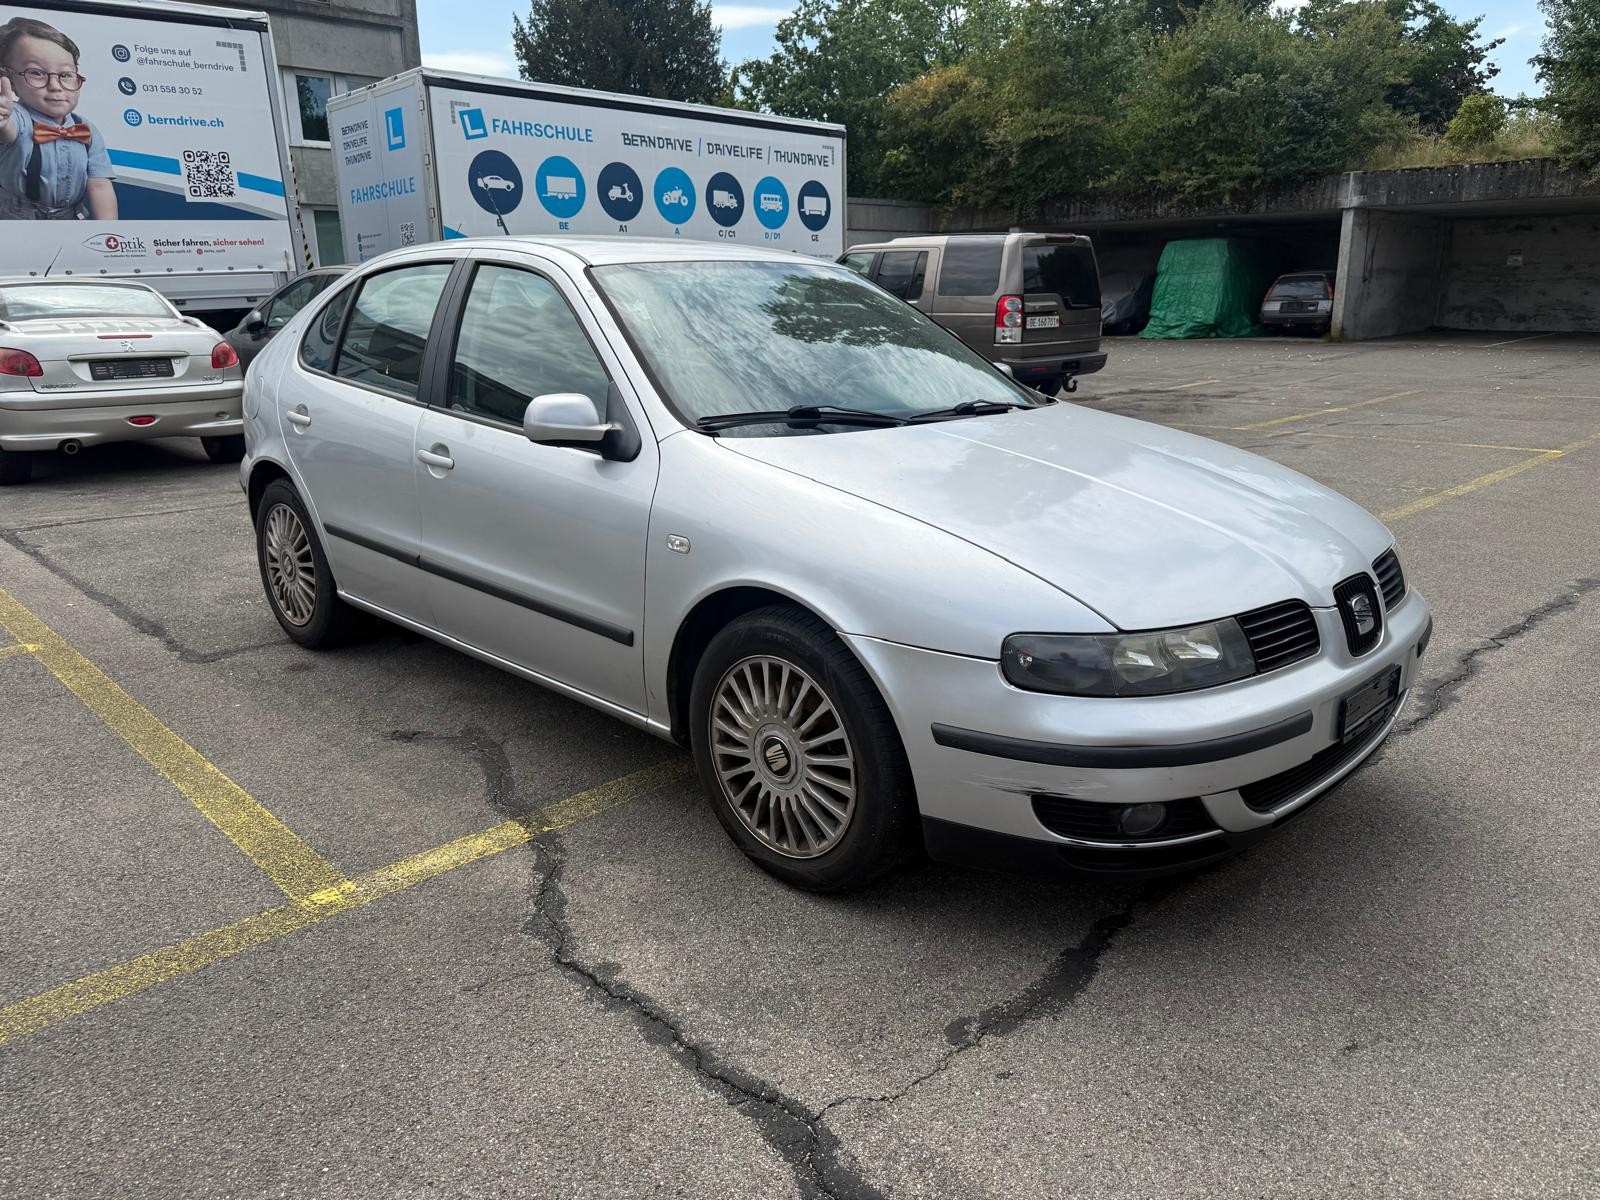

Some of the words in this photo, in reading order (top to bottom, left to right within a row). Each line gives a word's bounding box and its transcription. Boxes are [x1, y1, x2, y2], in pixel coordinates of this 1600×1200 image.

[134, 44, 159, 55] Folge
[160, 48, 176, 56] uns
[178, 48, 192, 57] auf
[136, 56, 234, 72] @fahrschule_berndrive
[142, 84, 158, 92] 031
[160, 85, 176, 94] 558
[178, 86, 190, 94] 30
[192, 87, 203, 95] 52
[147, 114, 224, 128] berndrive.ch
[492, 118, 594, 143] FAHRSCHULE
[621, 132, 693, 152] BERNDRIVE
[706, 142, 763, 160] DRIVELIFE
[774, 150, 829, 168] THUNDRIVE
[351, 176, 416, 204] FAHRSCHULE
[558, 221, 570, 230] BE
[618, 224, 628, 233] A1
[674, 227, 681, 236] A
[153, 238, 180, 247] Sicher
[182, 238, 211, 248] fahren,
[213, 237, 238, 247] sicher
[239, 237, 265, 246] sehen!
[811, 234, 819, 242] CE
